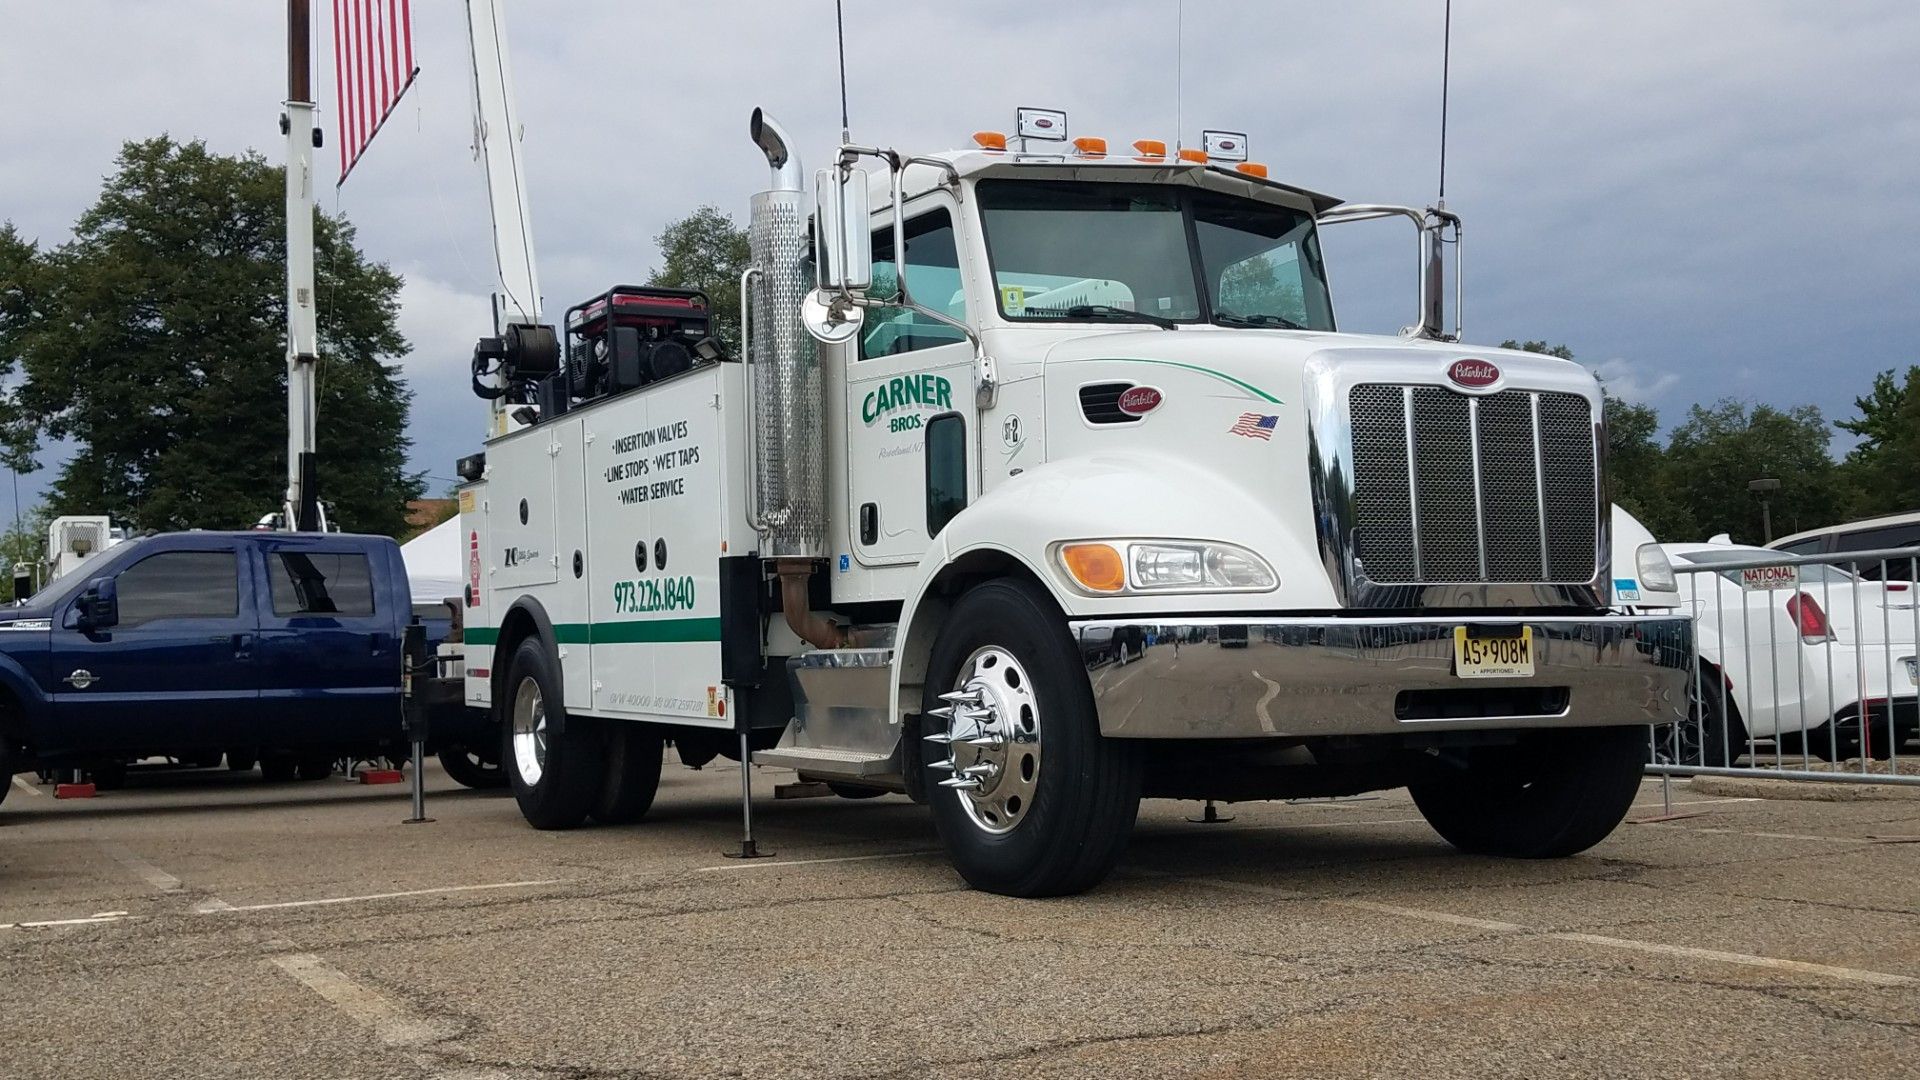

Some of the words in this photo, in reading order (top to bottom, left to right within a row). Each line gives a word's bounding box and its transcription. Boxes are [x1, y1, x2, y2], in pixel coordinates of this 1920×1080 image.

[1455, 362, 1496, 379] Peterbilt
[862, 374, 953, 424] CARNER
[657, 420, 688, 443] VALVES
[625, 458, 649, 479] STOPS
[678, 446, 700, 467] TAPS
[650, 478, 685, 500] SERVICE
[1743, 566, 1796, 581] NATIONAL
[614, 575, 695, 614] 973.226.1840
